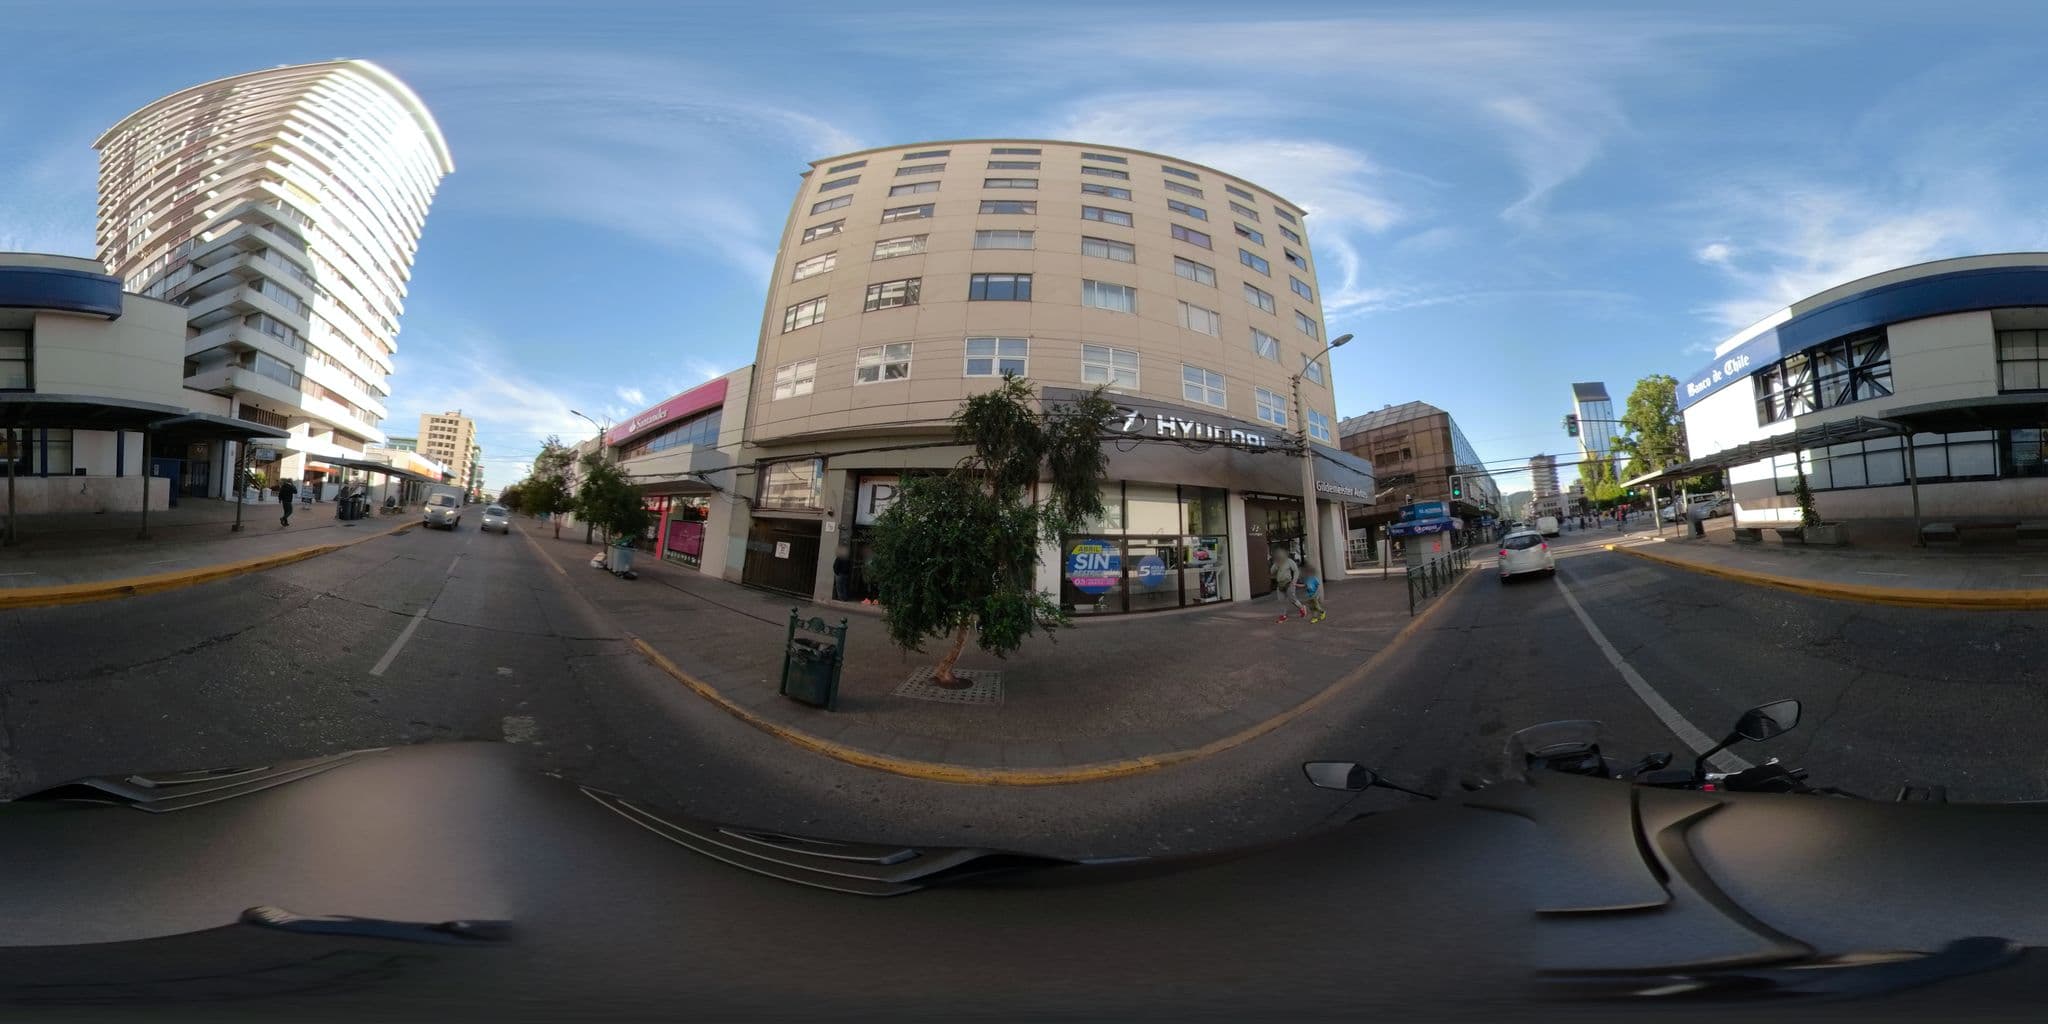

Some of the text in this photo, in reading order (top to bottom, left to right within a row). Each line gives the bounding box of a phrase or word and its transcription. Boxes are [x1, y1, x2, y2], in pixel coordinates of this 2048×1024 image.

[1686, 354, 1750, 398] Banco de Chile
[635, 407, 668, 429] Santander
[1074, 553, 1110, 570] SIN
[1139, 565, 1151, 577] 5
